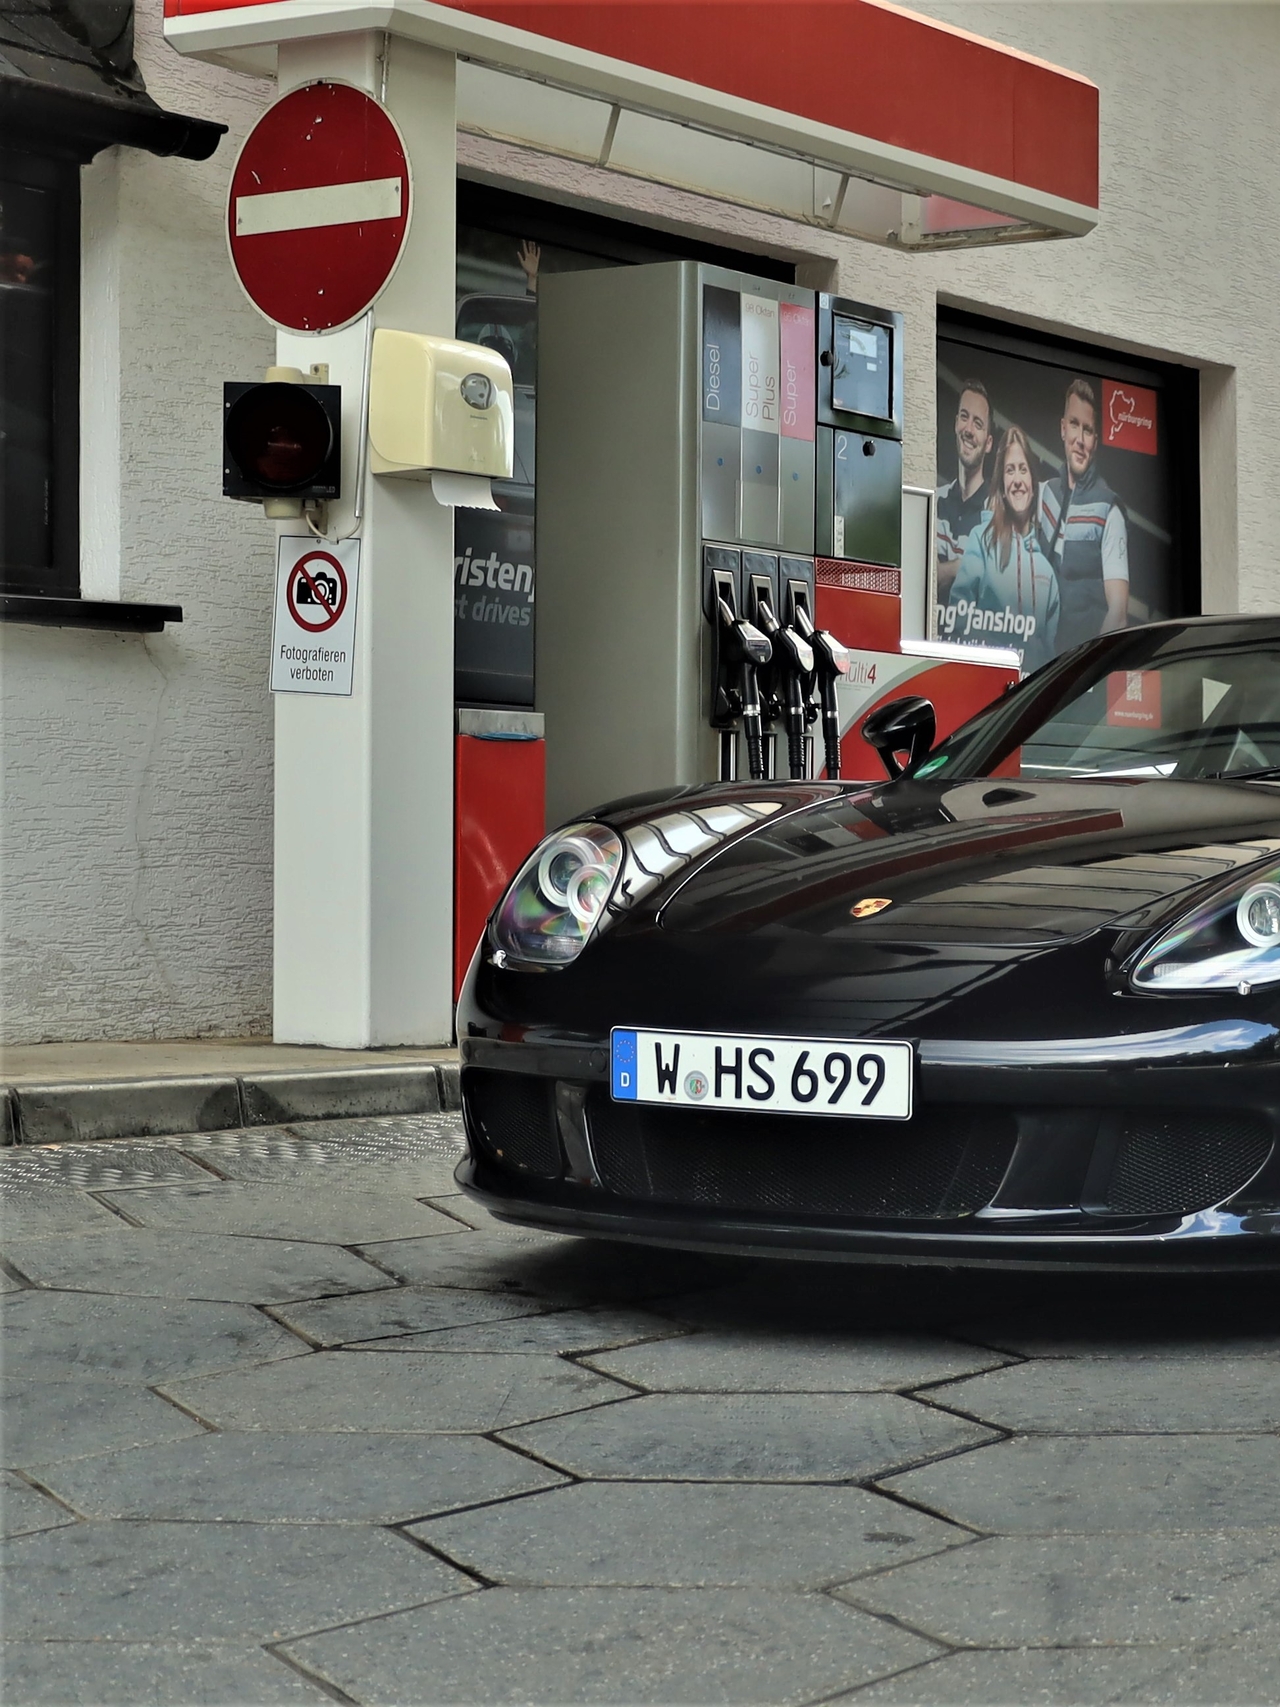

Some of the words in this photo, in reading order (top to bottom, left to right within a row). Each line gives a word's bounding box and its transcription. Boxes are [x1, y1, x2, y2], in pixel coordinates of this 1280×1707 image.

[706, 343, 721, 411] Diesel
[746, 352, 762, 418] Super
[783, 359, 799, 426] Super
[762, 375, 776, 422] Plus
[837, 435, 848, 460] 2
[472, 595, 531, 626] drives
[280, 644, 346, 664] Fotografieren
[290, 666, 334, 682] verboten
[620, 1072, 630, 1088] D
[654, 1042, 680, 1095] W
[714, 1045, 776, 1101] HS
[790, 1050, 886, 1106] 699
